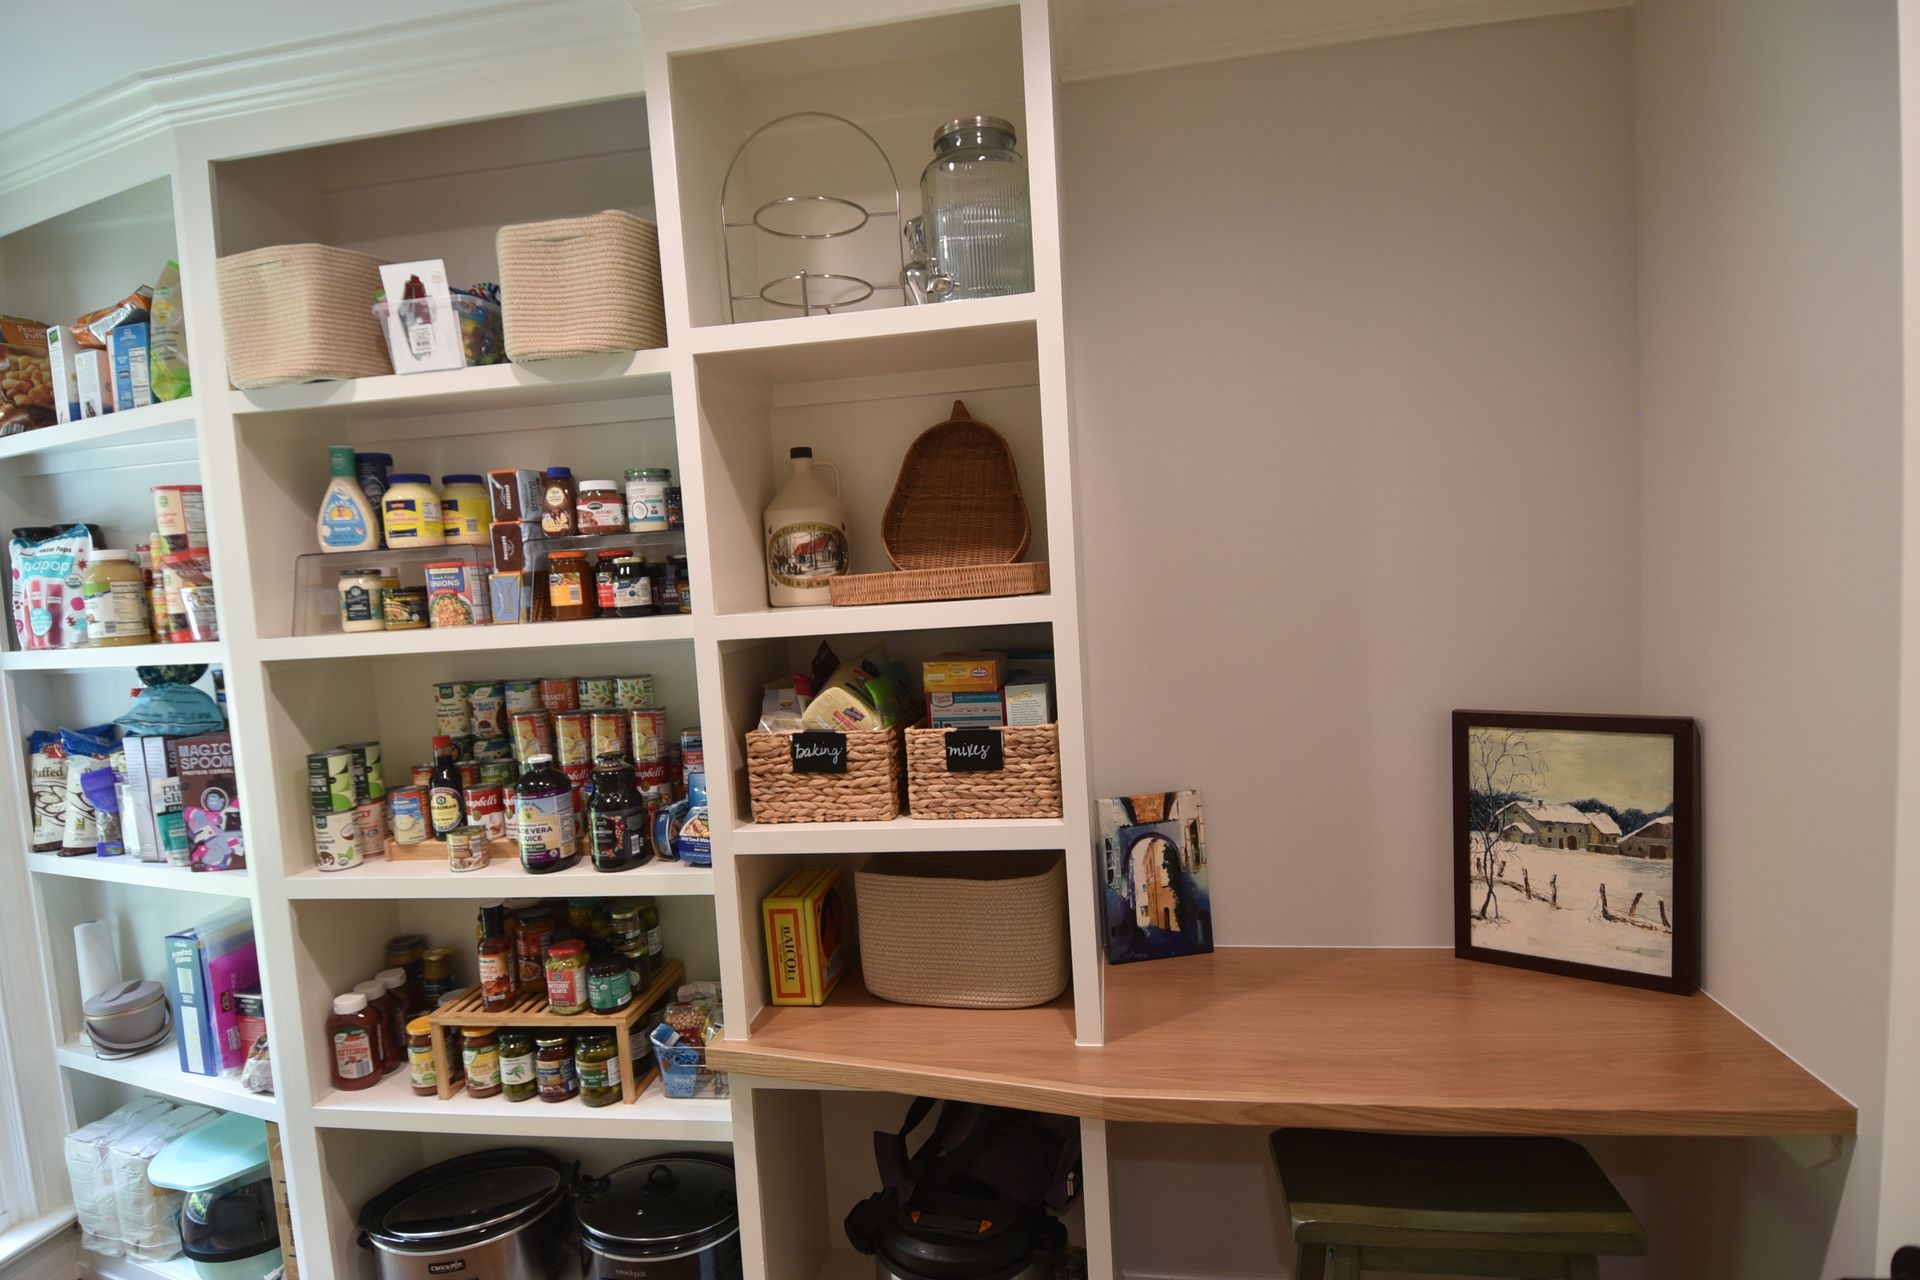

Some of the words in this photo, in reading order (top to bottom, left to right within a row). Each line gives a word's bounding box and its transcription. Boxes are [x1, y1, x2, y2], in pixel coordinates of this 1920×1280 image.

[24, 560, 70, 575] odpop
[430, 578, 460, 588] ONIONS
[178, 743, 231, 758] MAGIC
[794, 741, 843, 765] baking
[947, 742, 990, 760] mixes
[181, 755, 232, 769] SPOON
[530, 826, 553, 834] VERA
[783, 926, 797, 980] BAICOLI
